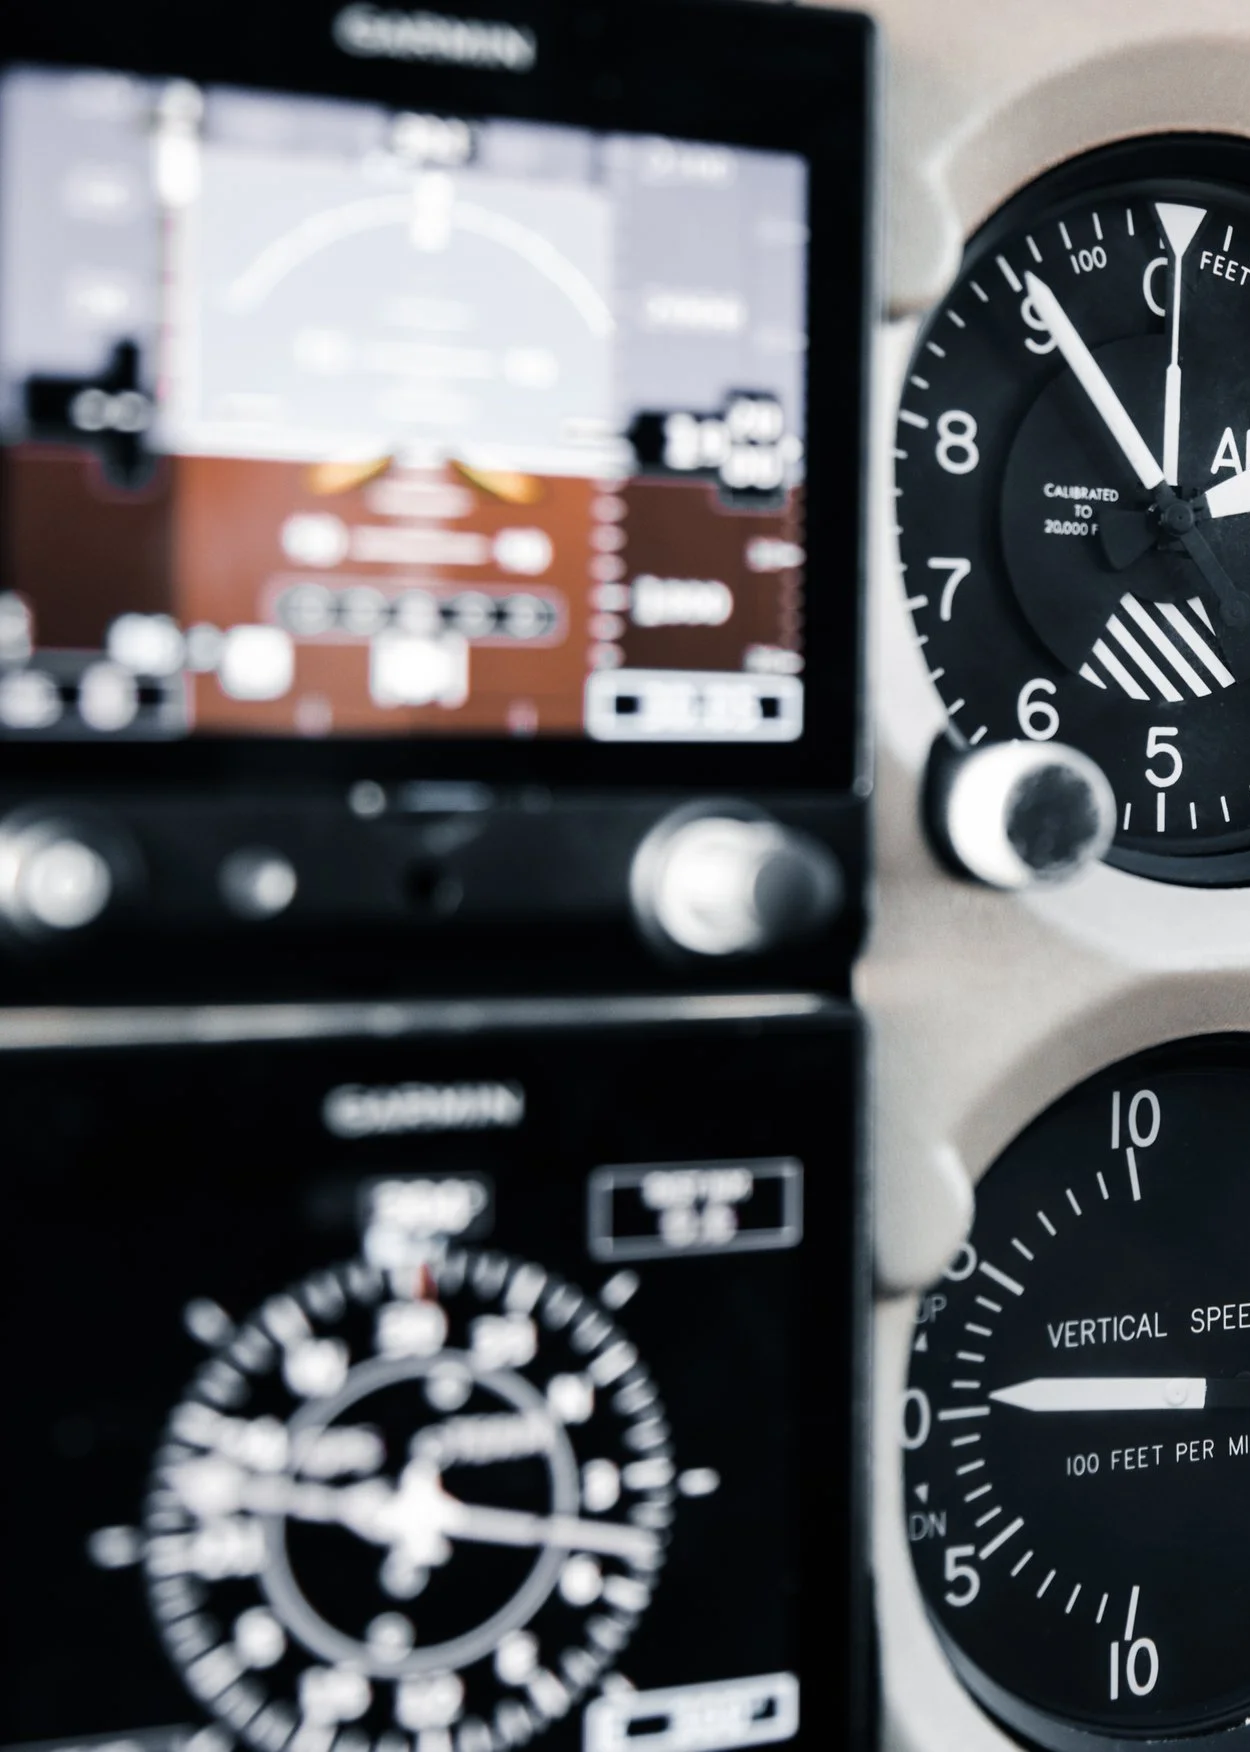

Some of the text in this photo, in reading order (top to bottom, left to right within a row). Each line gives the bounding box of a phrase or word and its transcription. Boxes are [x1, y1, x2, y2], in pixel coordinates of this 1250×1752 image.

[1069, 246, 1107, 274] 100
[1021, 297, 1058, 354] 9
[936, 410, 979, 475] 8
[1043, 482, 1119, 502] CALIBRATED
[1074, 504, 1093, 519] TO
[927, 558, 971, 622] 7
[1017, 678, 1059, 741] 6
[1145, 726, 1183, 788] 5
[1111, 1089, 1161, 1149] 10
[1047, 1311, 1168, 1349] VERTICAL
[900, 1387, 931, 1450] 0
[1066, 1452, 1100, 1477] 100
[1111, 1444, 1164, 1470] FEET
[1175, 1439, 1215, 1463] PER
[909, 1511, 947, 1541] DN
[944, 1544, 981, 1607] 5
[1110, 1637, 1159, 1701] 10
